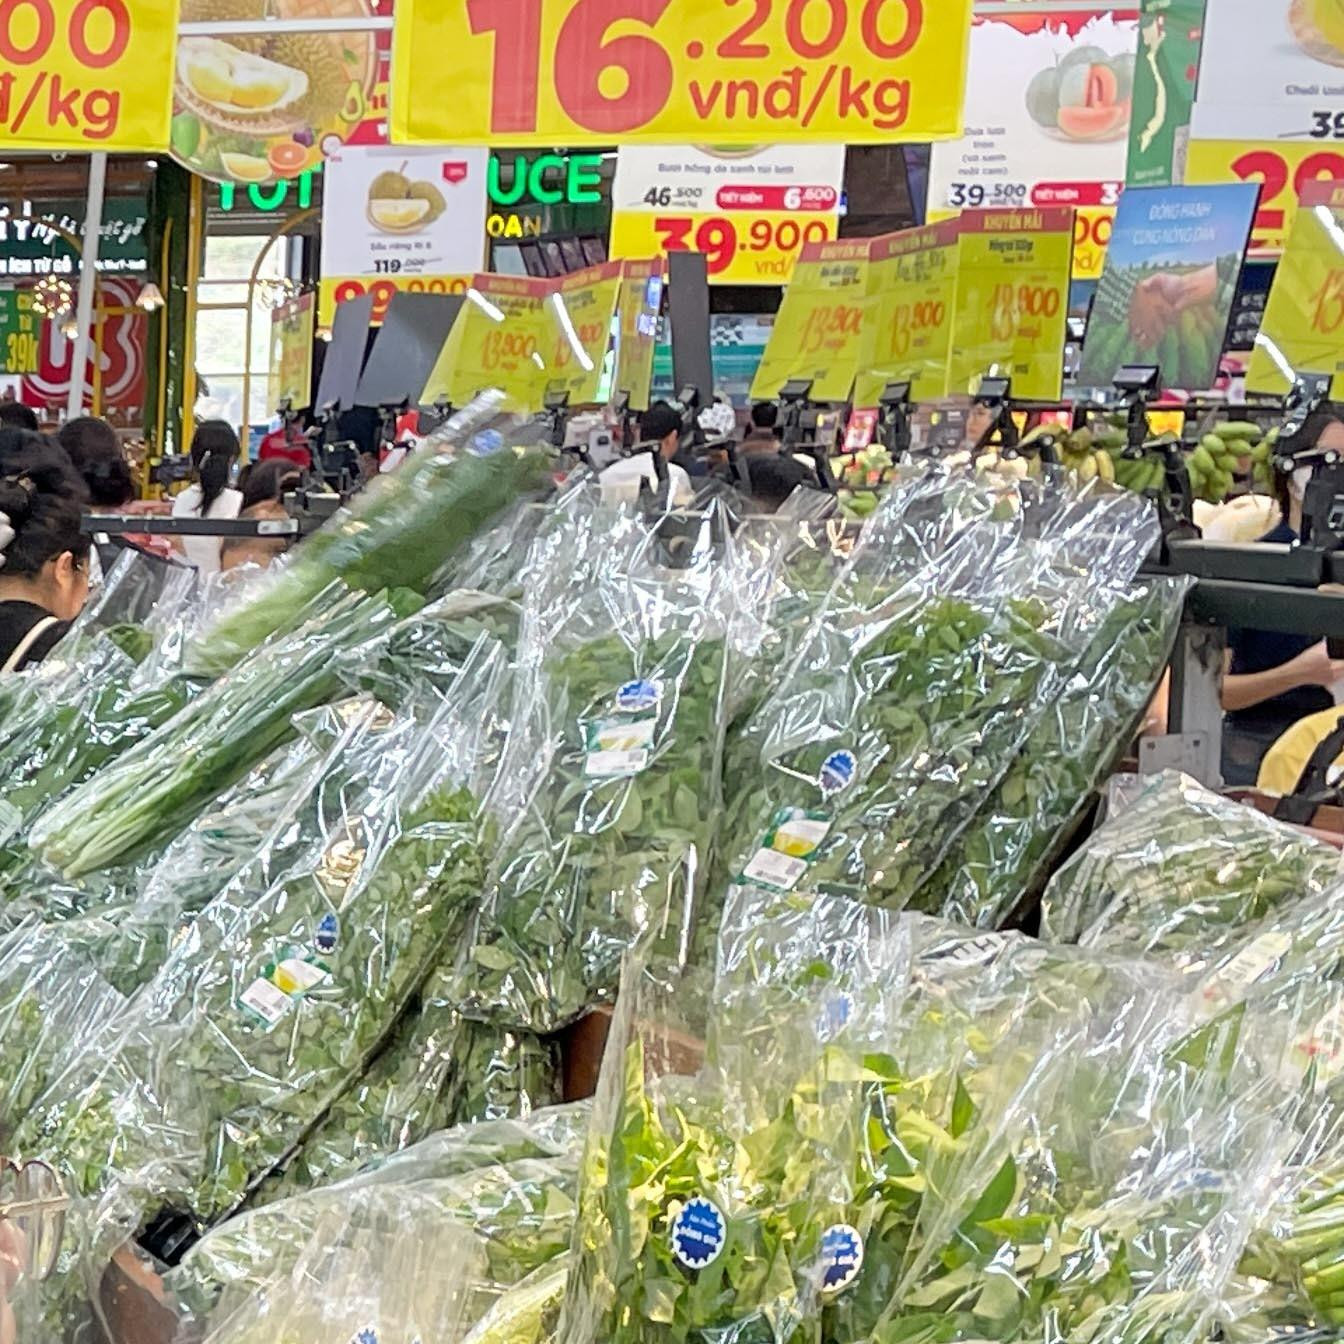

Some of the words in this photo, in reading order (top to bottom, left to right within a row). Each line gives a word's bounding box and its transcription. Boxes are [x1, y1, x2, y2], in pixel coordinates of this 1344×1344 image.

[467, 0, 924, 135] 16.200
[688, 65, 912, 129] vnđ/kg
[488, 154, 604, 205] UCE
[654, 217, 830, 275] 39.900
[755, 257, 798, 277] vnđ/
